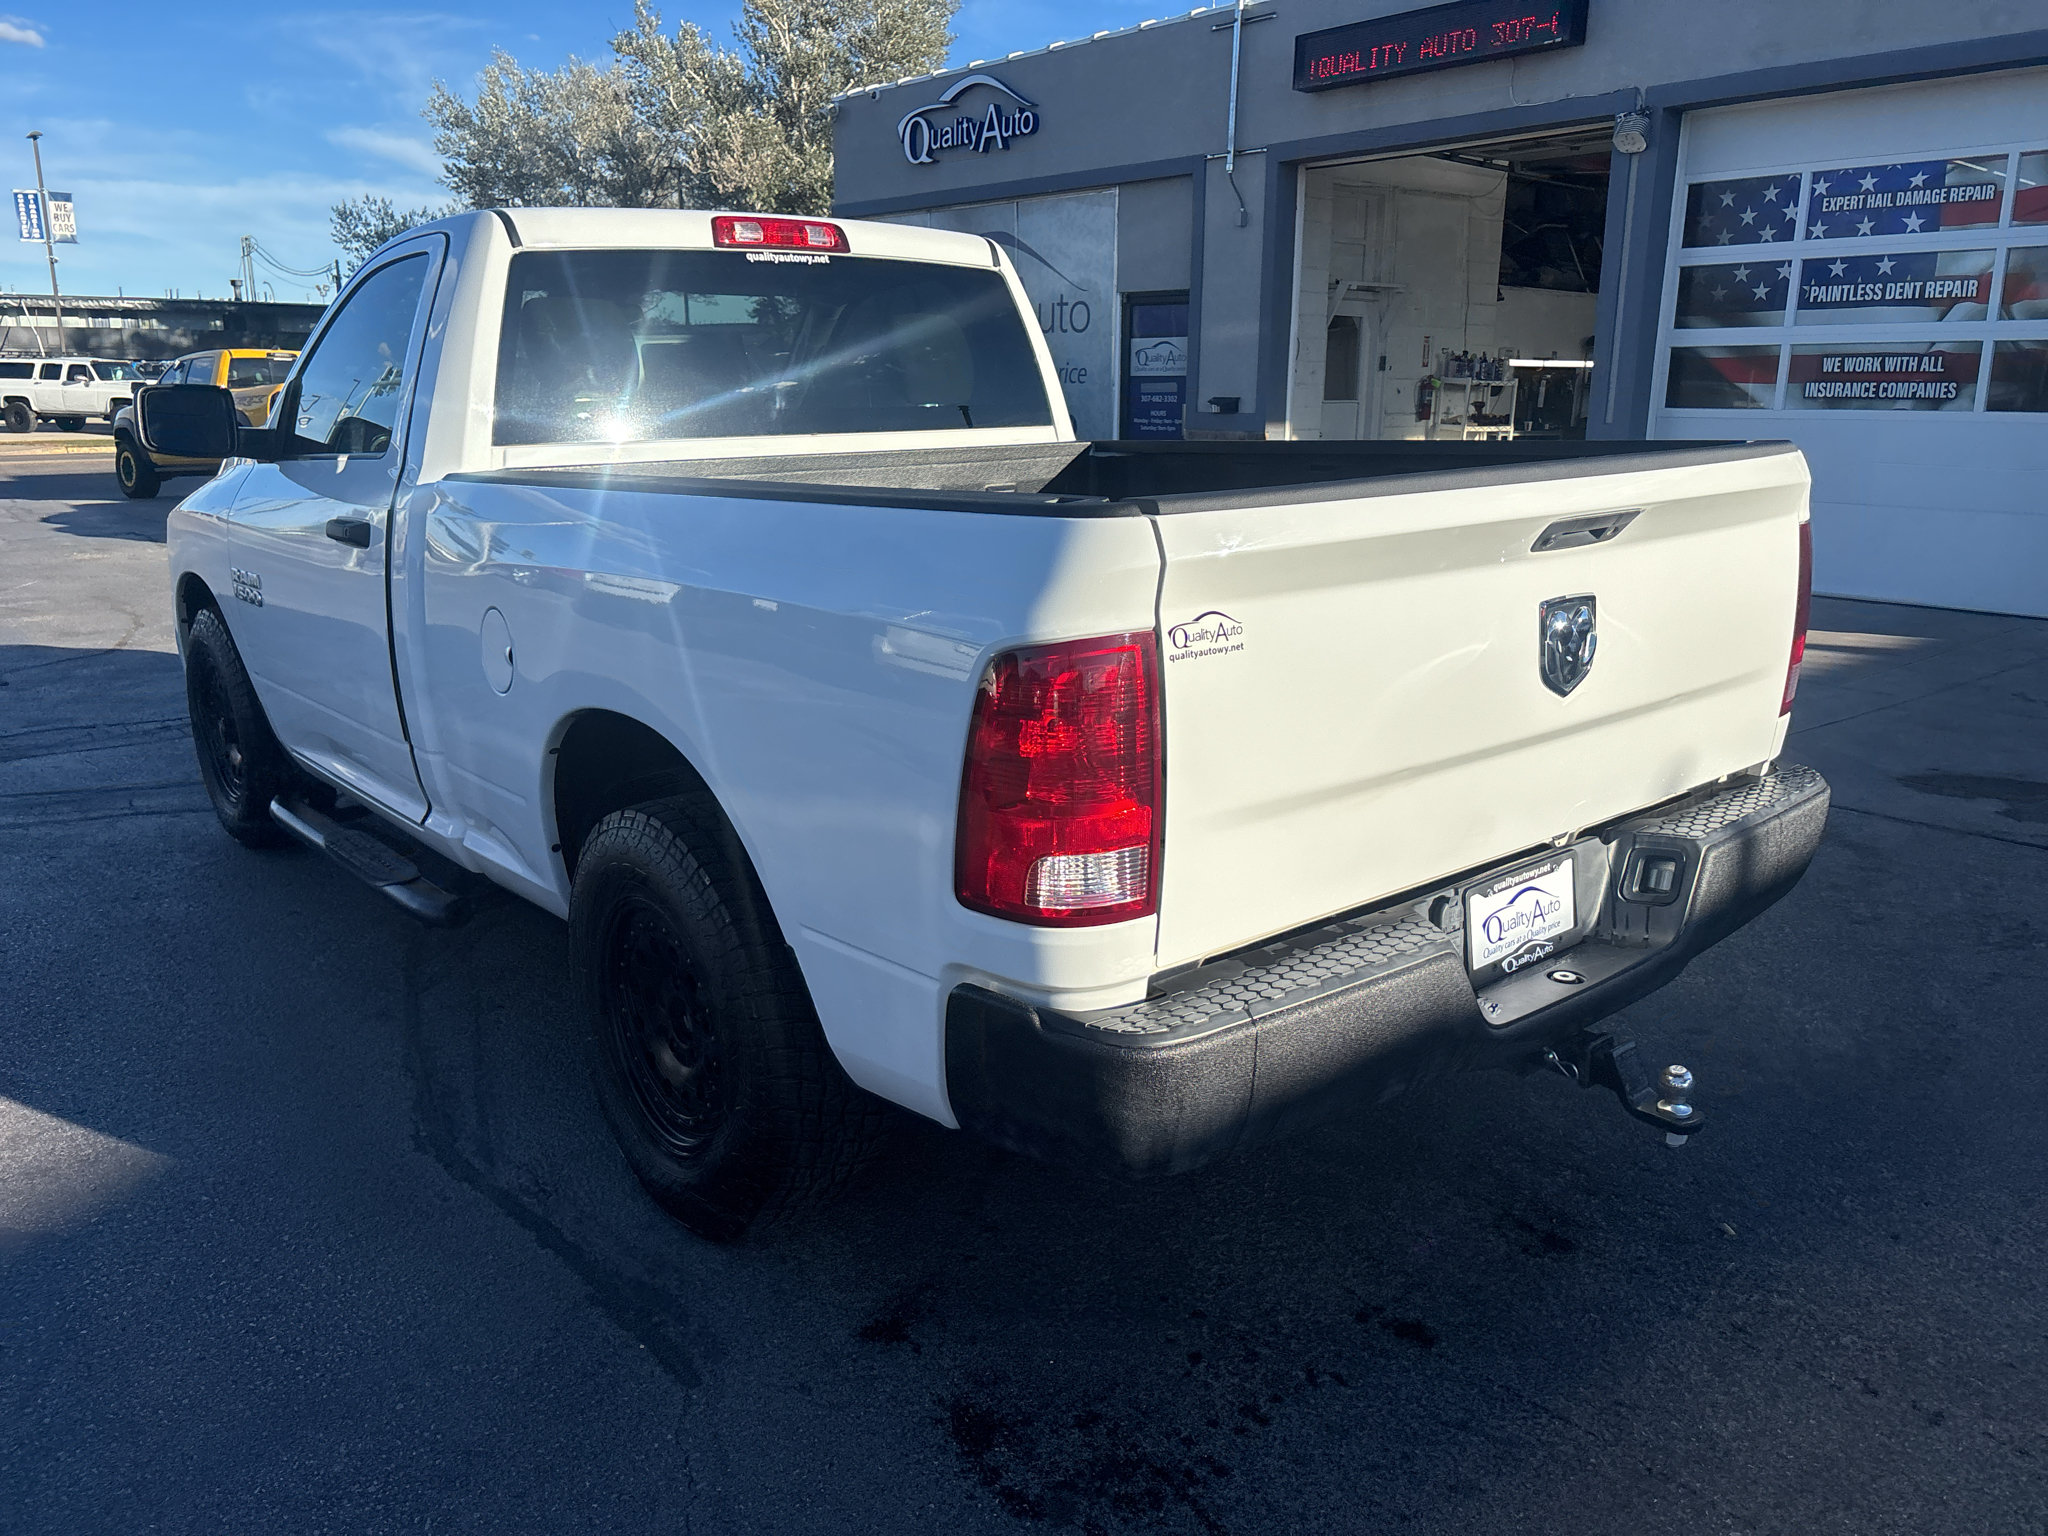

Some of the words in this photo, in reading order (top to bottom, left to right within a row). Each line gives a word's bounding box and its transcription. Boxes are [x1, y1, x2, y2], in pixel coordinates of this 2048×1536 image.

[1419, 28, 1477, 59] AUTO
[54, 203, 68, 213] WE
[1822, 193, 1865, 212] EXPERT
[1866, 190, 1895, 209] HAIL
[1896, 187, 1947, 206] DAMAGE
[1949, 184, 1996, 203] REPAIR
[52, 223, 75, 233] CARS
[53, 213, 71, 223] BUY
[746, 252, 830, 265] qualityautowy.net
[1810, 283, 1883, 303] PAINTLESS
[1885, 281, 1924, 300] DENT
[1926, 279, 1979, 299] REPAIR
[1823, 357, 1842, 373] WE
[1844, 356, 1882, 372] WORK
[1885, 356, 1918, 372] WITH
[1920, 356, 1945, 372] ALL
[1805, 382, 1877, 398] INSURANCE
[1879, 382, 1957, 399] COMPANIES
[231, 567, 262, 590] RAM
[1169, 643, 1244, 663] qualityautowy.net
[1493, 863, 1551, 892] qualityautowy.net
[1483, 942, 1503, 959] Quality
[1504, 938, 1516, 949] cars
[1526, 926, 1547, 940] Quality
[1547, 920, 1561, 933] price
